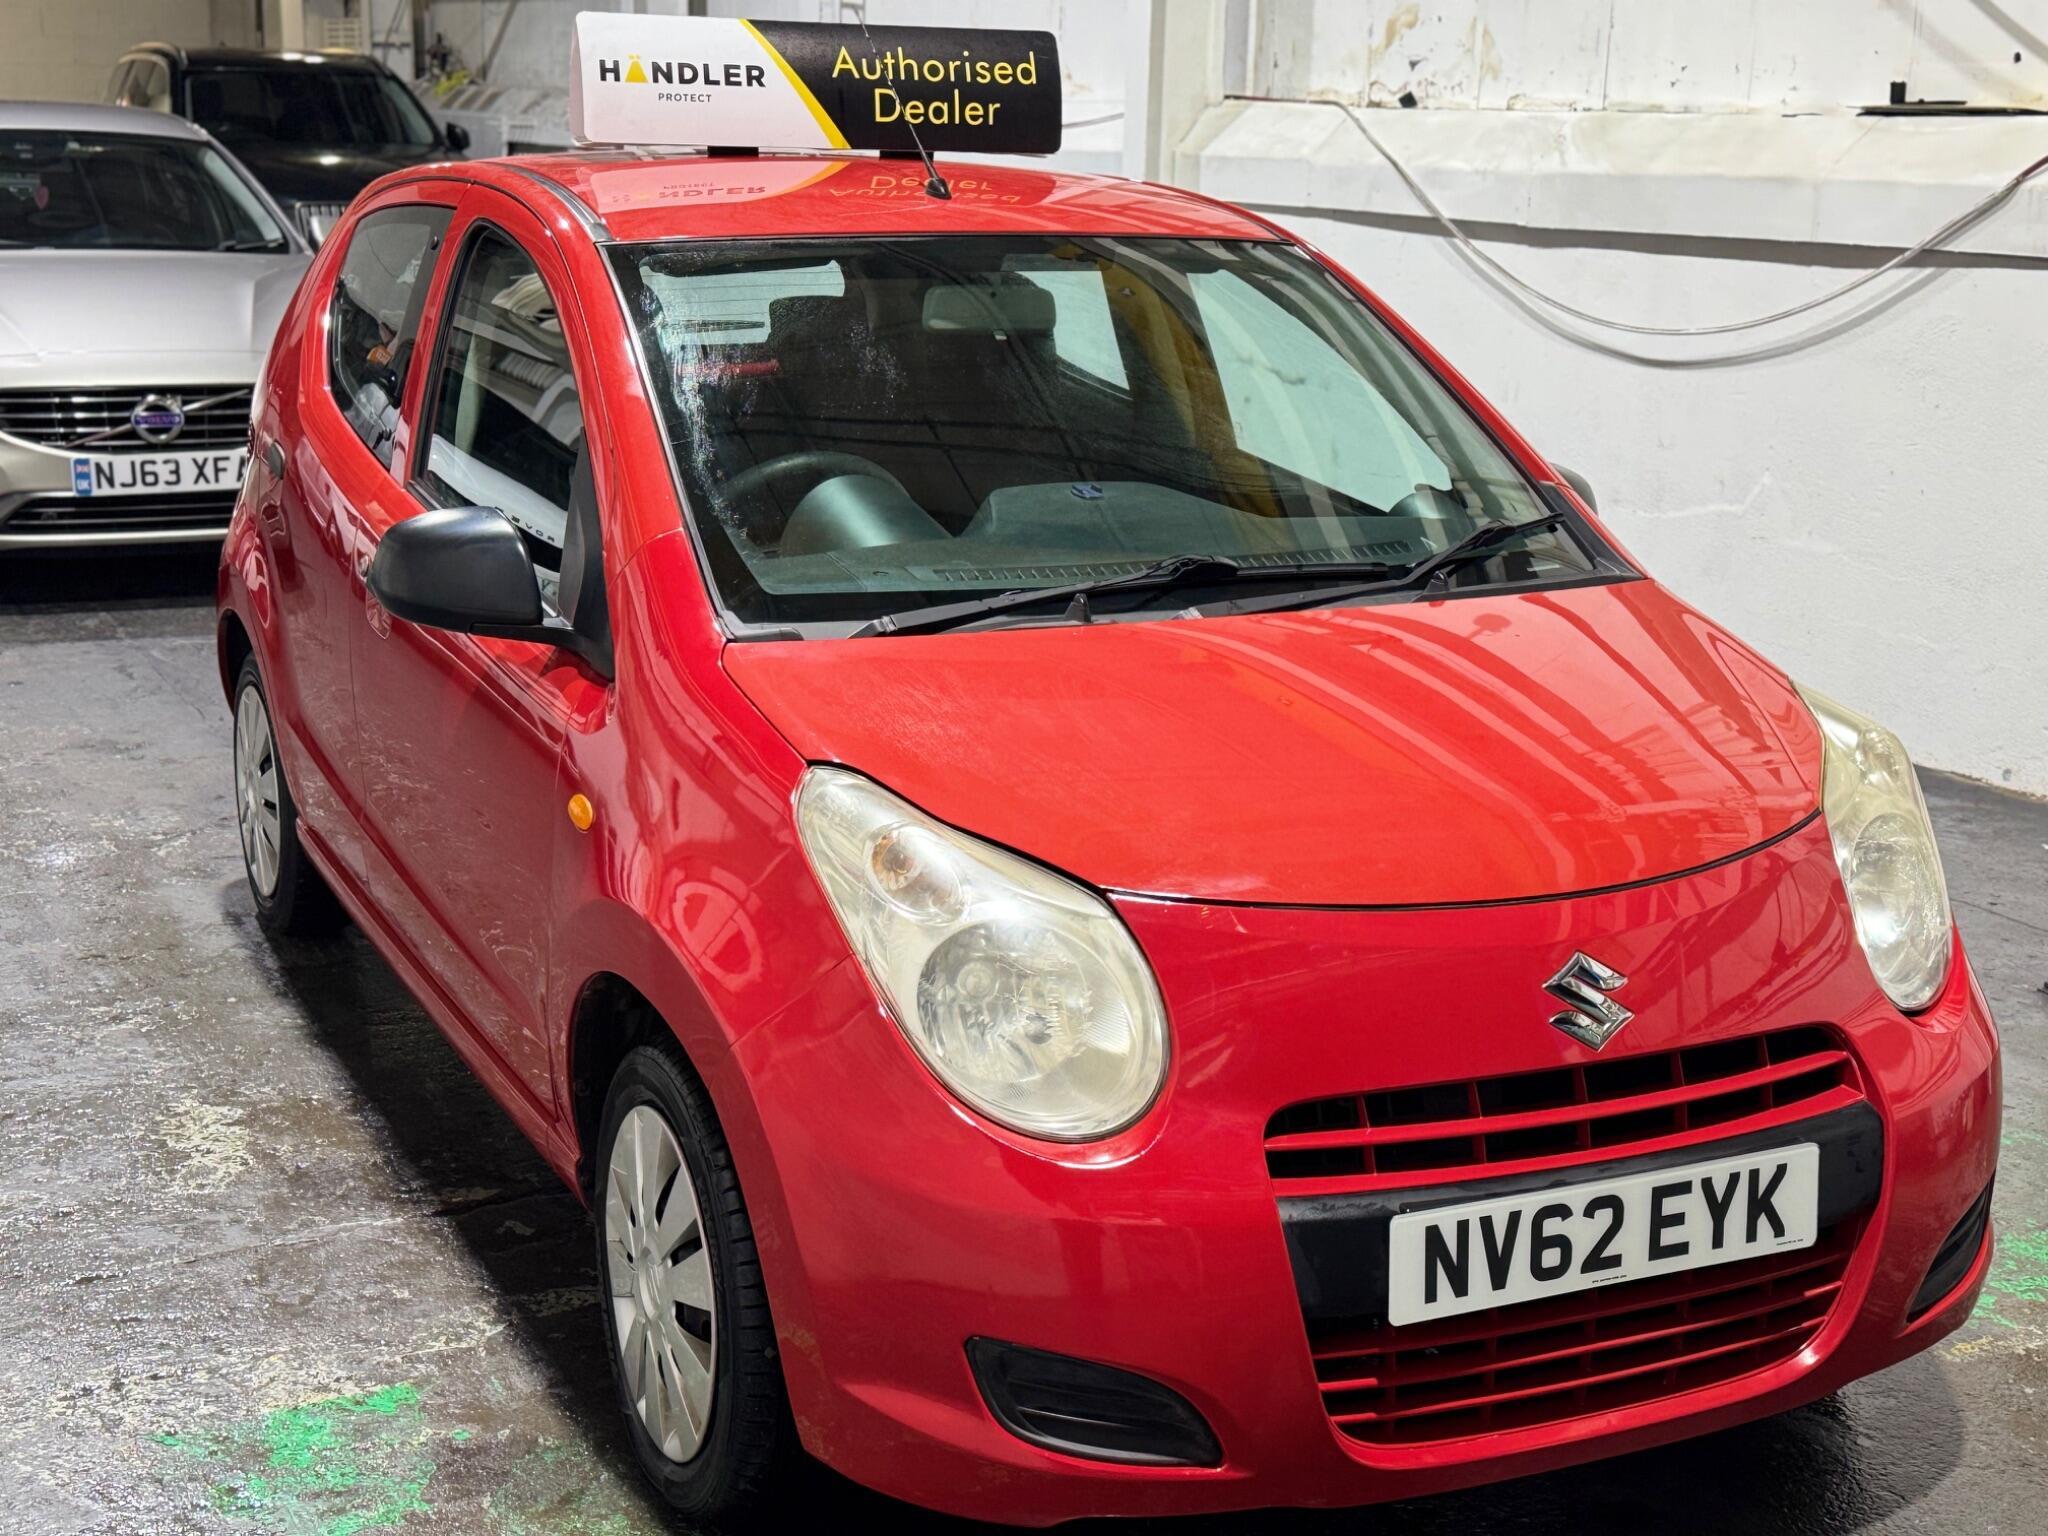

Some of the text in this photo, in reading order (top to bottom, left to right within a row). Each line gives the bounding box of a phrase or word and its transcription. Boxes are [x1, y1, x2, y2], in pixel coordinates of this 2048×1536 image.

[831, 46, 1037, 85] Authorised
[658, 93, 712, 103] PROTECT
[874, 88, 1001, 126] Dealer
[95, 459, 181, 489] NJ63
[1424, 1162, 1788, 1305] NV62 EYK
